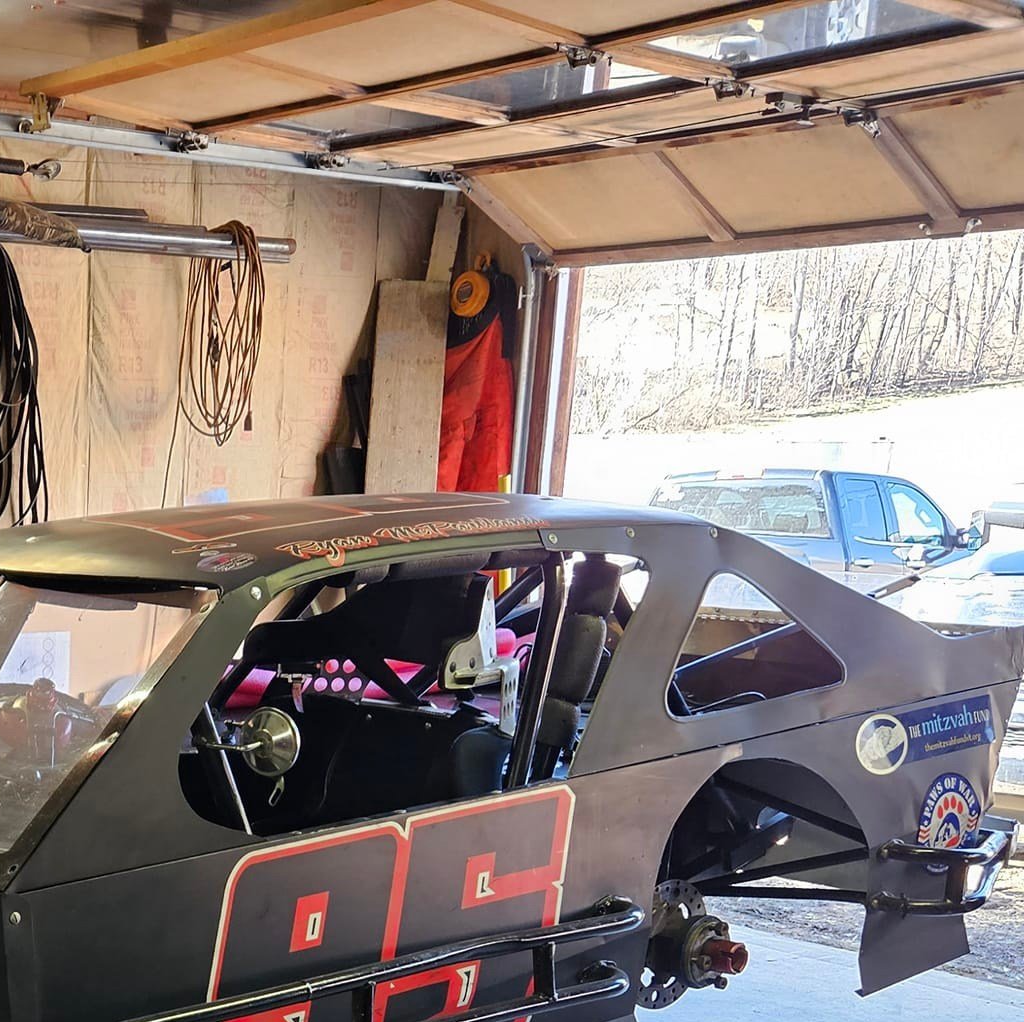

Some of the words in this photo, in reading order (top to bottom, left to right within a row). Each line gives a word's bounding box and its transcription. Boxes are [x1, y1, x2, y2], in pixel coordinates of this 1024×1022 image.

[276, 535, 379, 567] Ryan
[908, 724, 922, 739] THE
[921, 704, 974, 736] mitzvah
[973, 708, 990, 724] FUND
[924, 782, 943, 817] PAWS
[944, 777, 957, 790] OF
[958, 780, 975, 808] WAR
